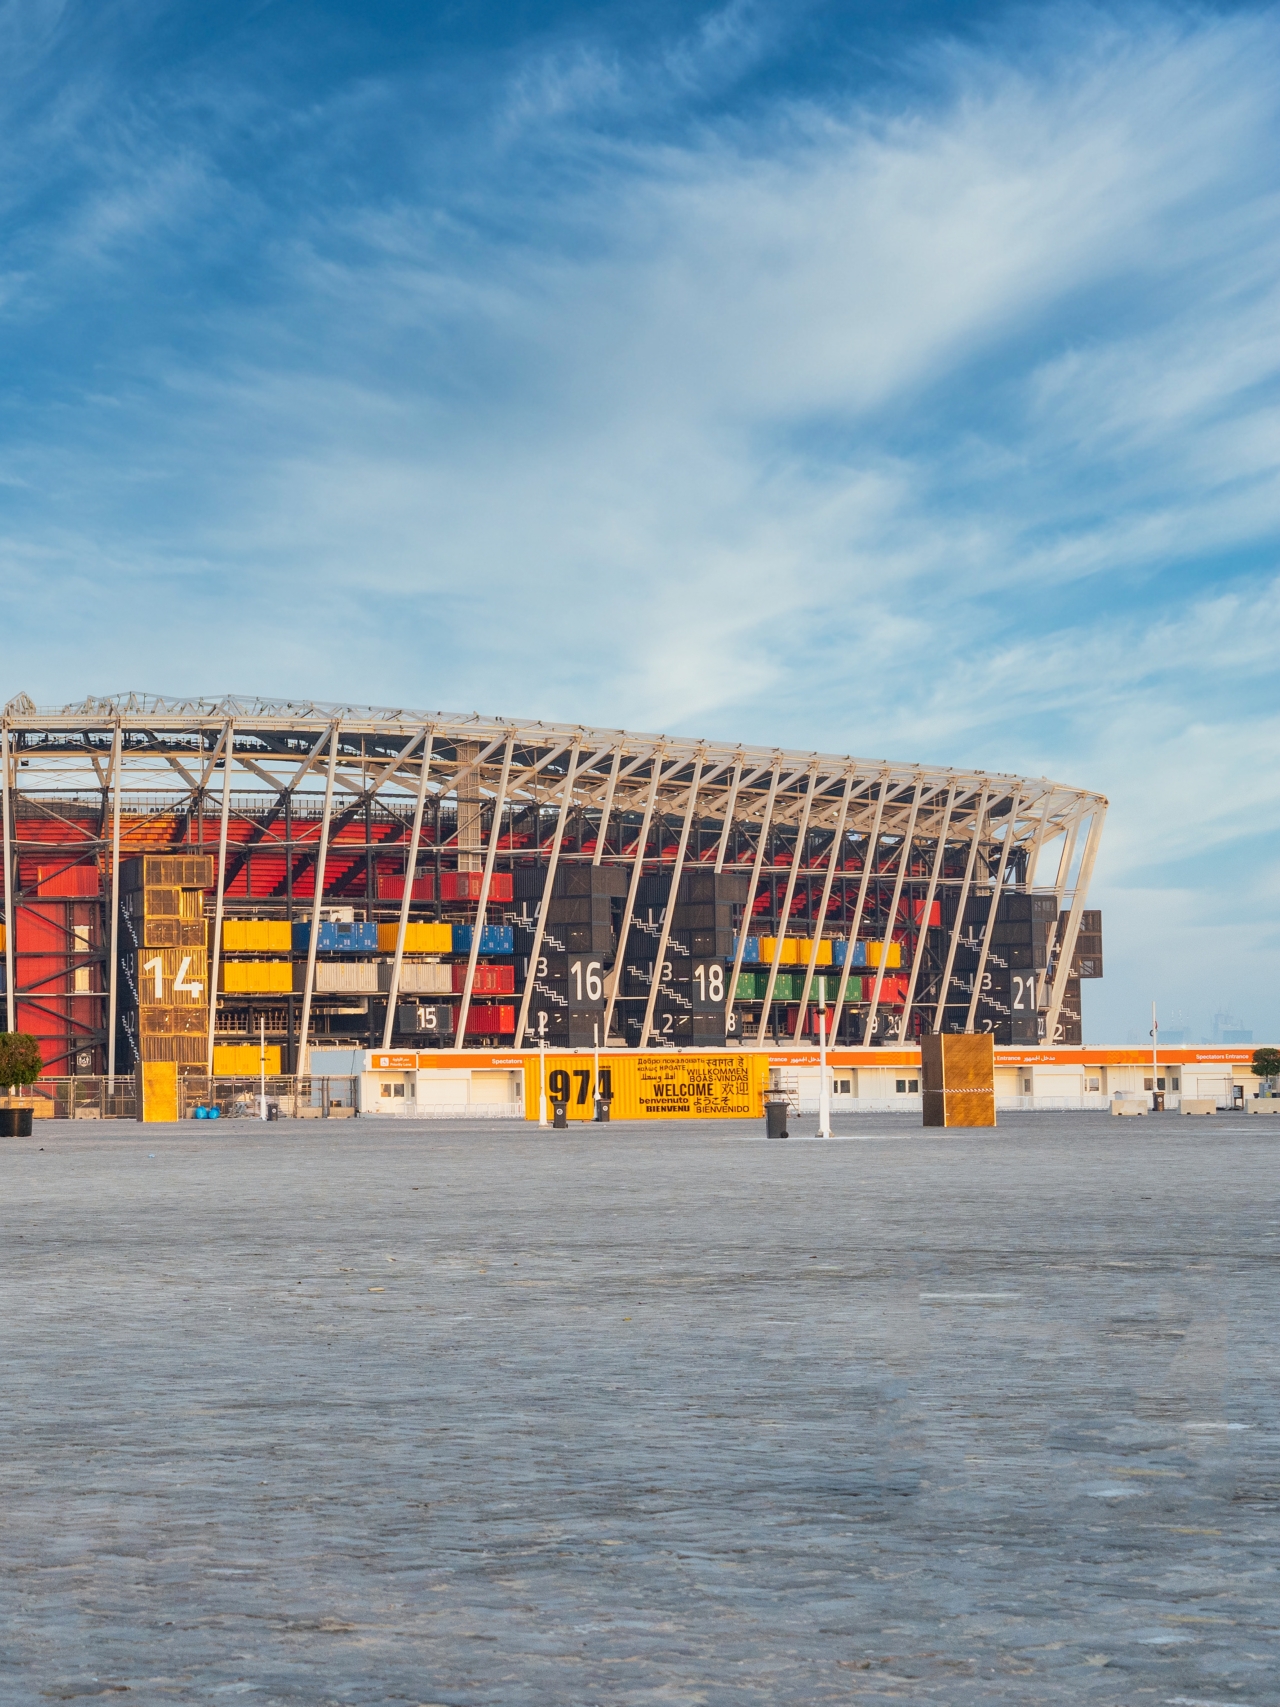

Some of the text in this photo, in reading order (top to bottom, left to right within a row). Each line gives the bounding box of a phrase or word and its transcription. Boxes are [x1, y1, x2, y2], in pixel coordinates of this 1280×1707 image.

[143, 956, 204, 998] 14
[570, 961, 602, 1001] 16
[694, 964, 724, 1002] 18
[1012, 976, 1035, 1010] 21
[417, 1007, 437, 1028] 15
[706, 1058, 734, 1067] स्वागत
[686, 1068, 748, 1076] WILLKOMMEN
[689, 1075, 749, 1083] BOAS-VINDAS
[549, 1070, 614, 1105] 974
[653, 1083, 714, 1096] WELCOME
[721, 1082, 749, 1096] 欢迎
[693, 1096, 731, 1106] ようこそ
[646, 1105, 690, 1113] BIENVENU
[696, 1105, 750, 1114] BIENVENIDO
